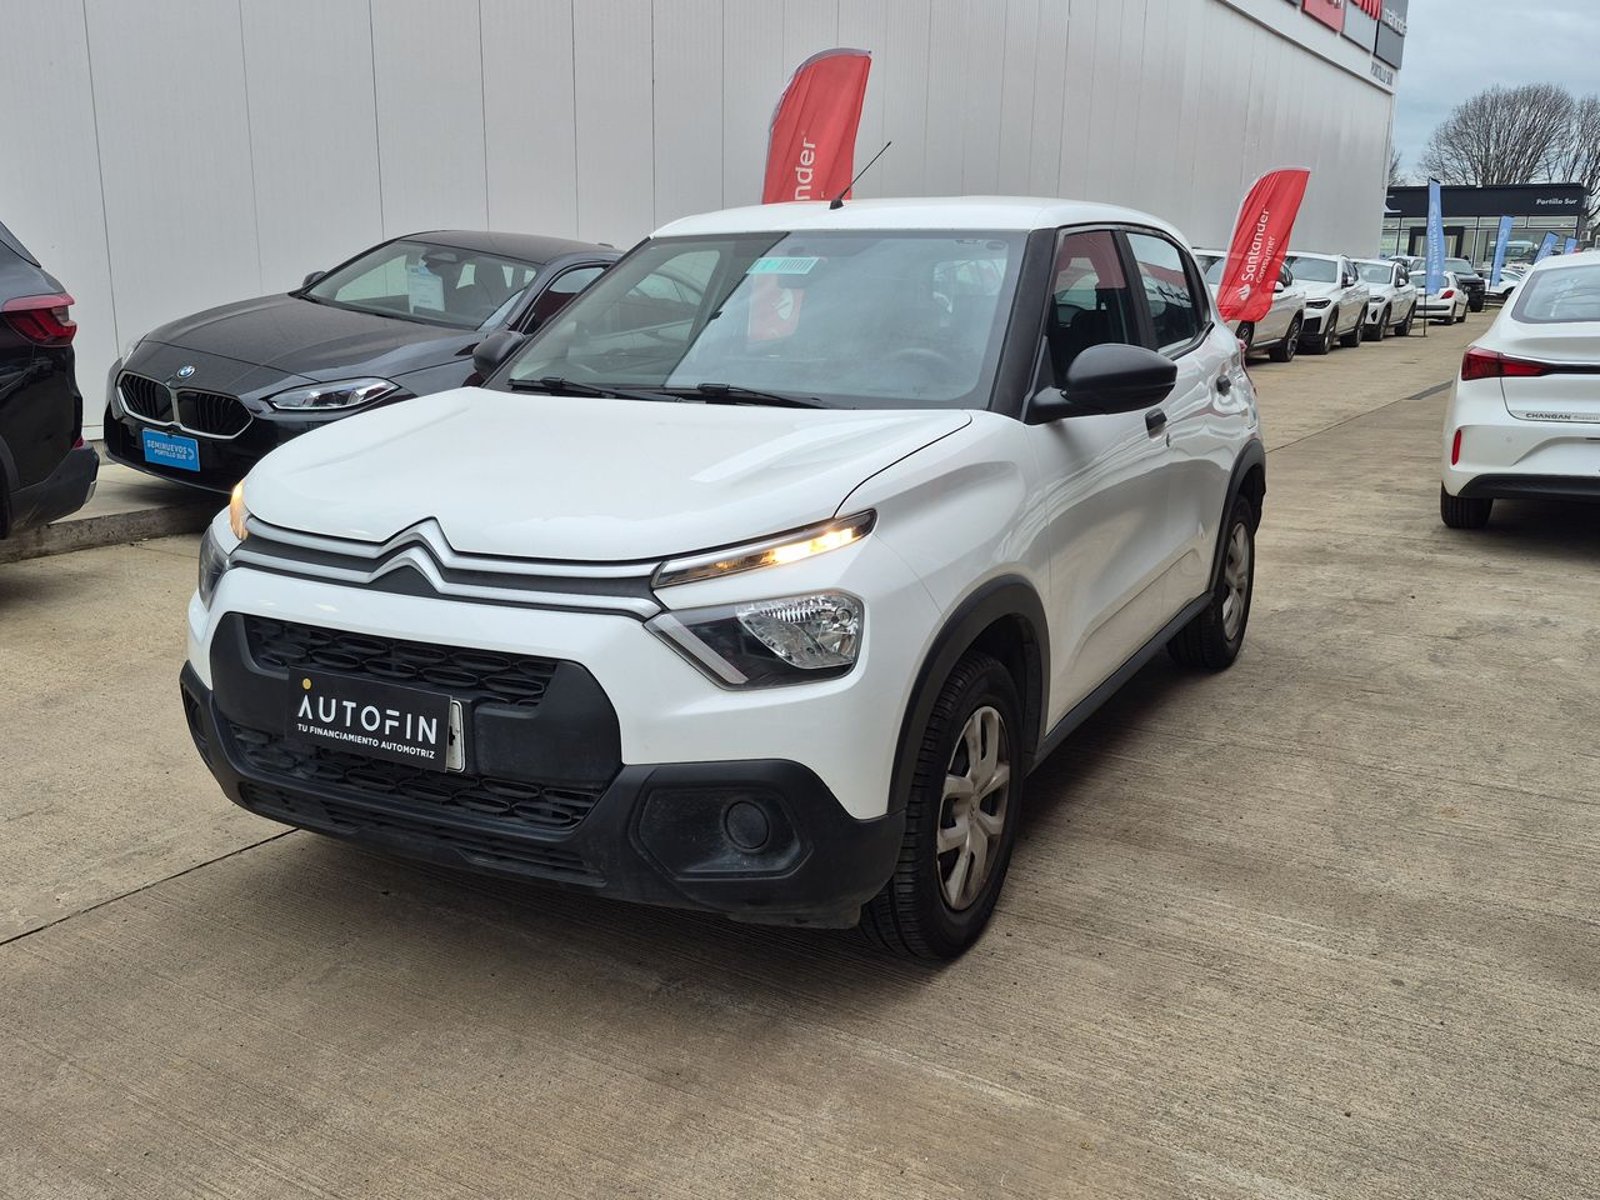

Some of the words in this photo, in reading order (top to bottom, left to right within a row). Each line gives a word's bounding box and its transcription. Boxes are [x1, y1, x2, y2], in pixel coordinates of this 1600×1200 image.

[1536, 197, 1563, 205] Portillo
[1564, 197, 1578, 205] Sur
[1241, 208, 1270, 281] Santander
[1255, 235, 1276, 283] Consumer
[146, 440, 187, 455] SEMINUEVOS
[298, 695, 437, 745] AUTOFIN
[298, 723, 308, 732] TU
[309, 726, 379, 747] FINANCIAMIENTO
[380, 741, 435, 759] AUTOMOTRIZ
